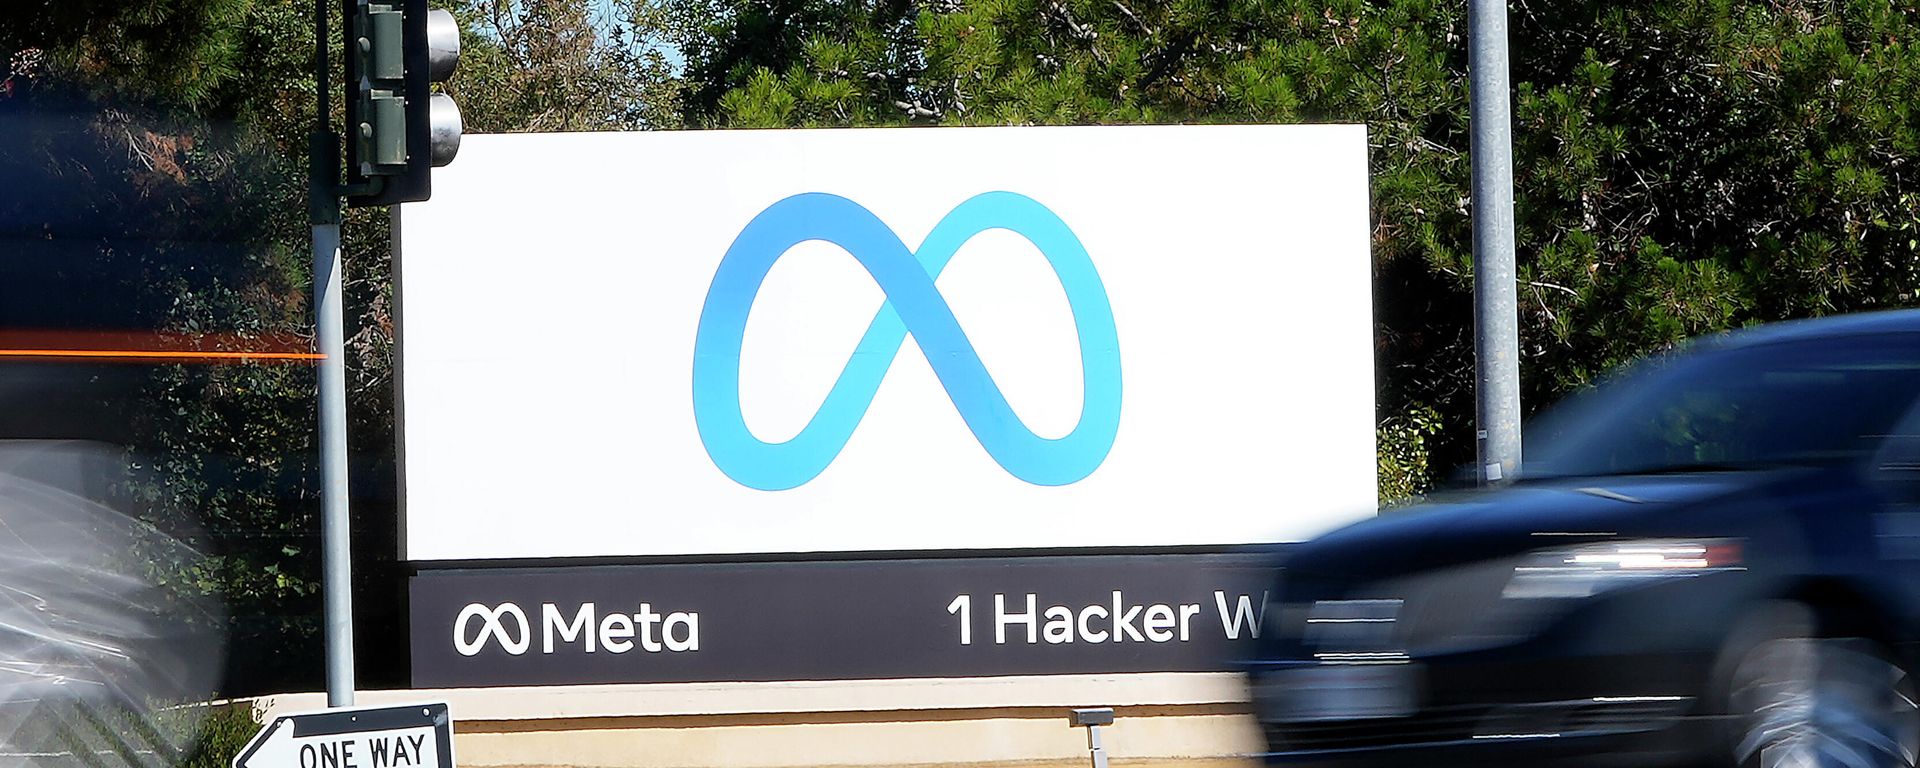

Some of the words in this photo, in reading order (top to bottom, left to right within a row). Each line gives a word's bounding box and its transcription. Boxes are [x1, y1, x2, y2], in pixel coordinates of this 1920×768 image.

[542, 603, 699, 653] Meta
[947, 594, 971, 645] 1
[994, 590, 1200, 644] Hacker
[300, 740, 357, 768] ONE
[369, 734, 425, 768] WAY
